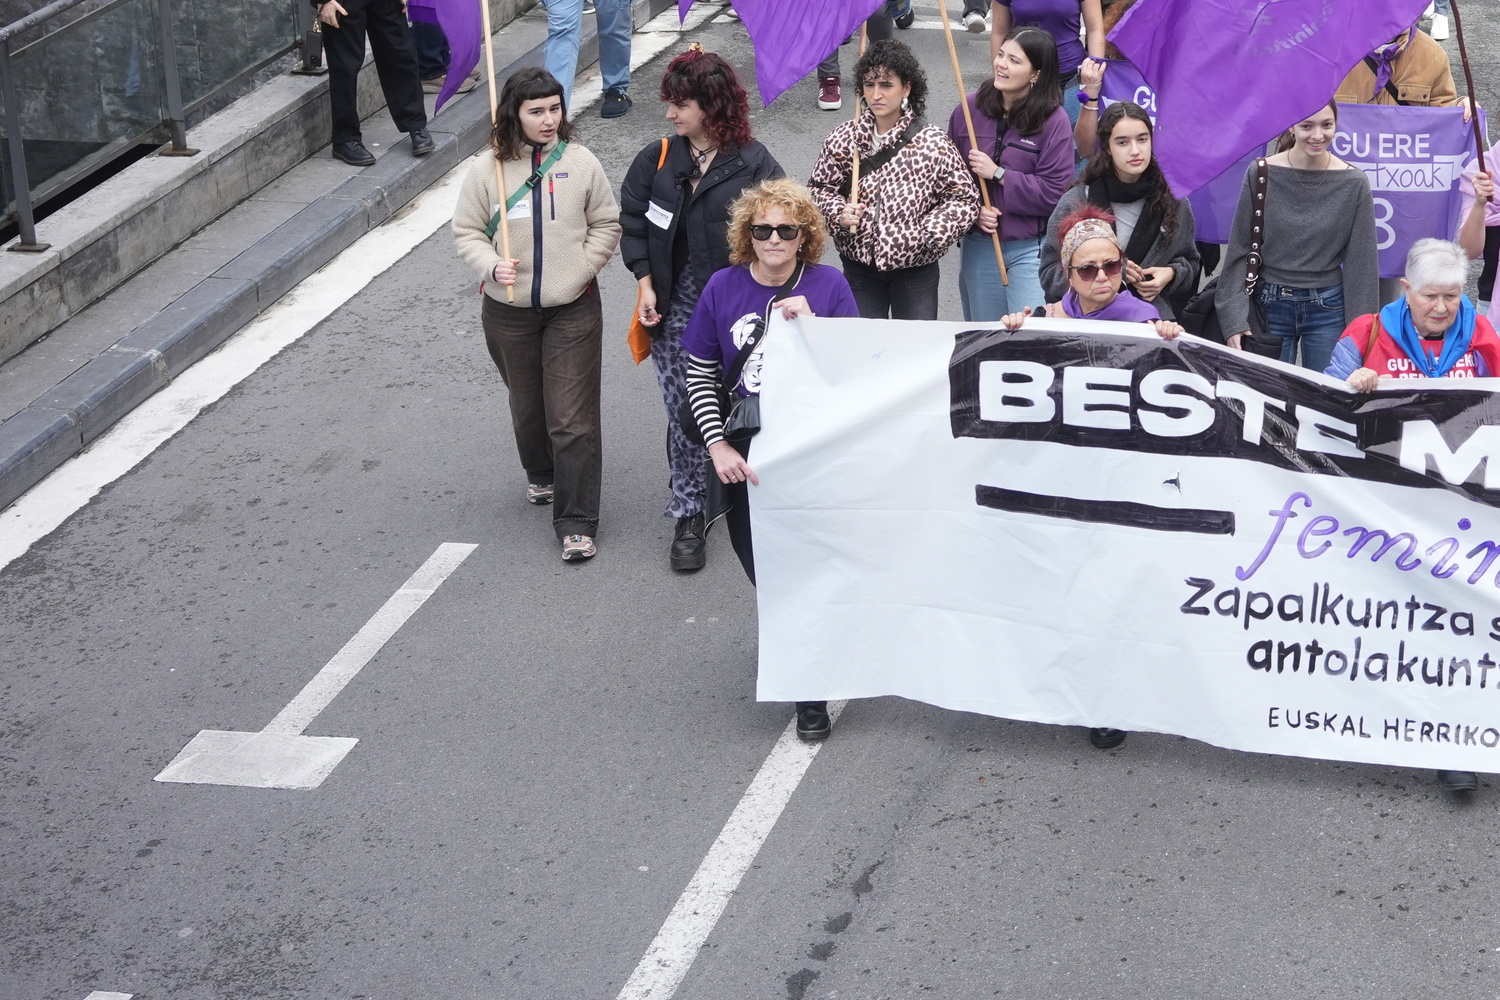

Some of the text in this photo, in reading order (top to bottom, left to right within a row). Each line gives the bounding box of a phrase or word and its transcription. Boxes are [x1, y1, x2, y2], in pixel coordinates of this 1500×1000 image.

[1332, 131, 1430, 158] GU ERE
[979, 360, 1366, 459] BESTE
[1269, 707, 1370, 739] EUSKAL
[1384, 719, 1499, 748] HERRIKO
